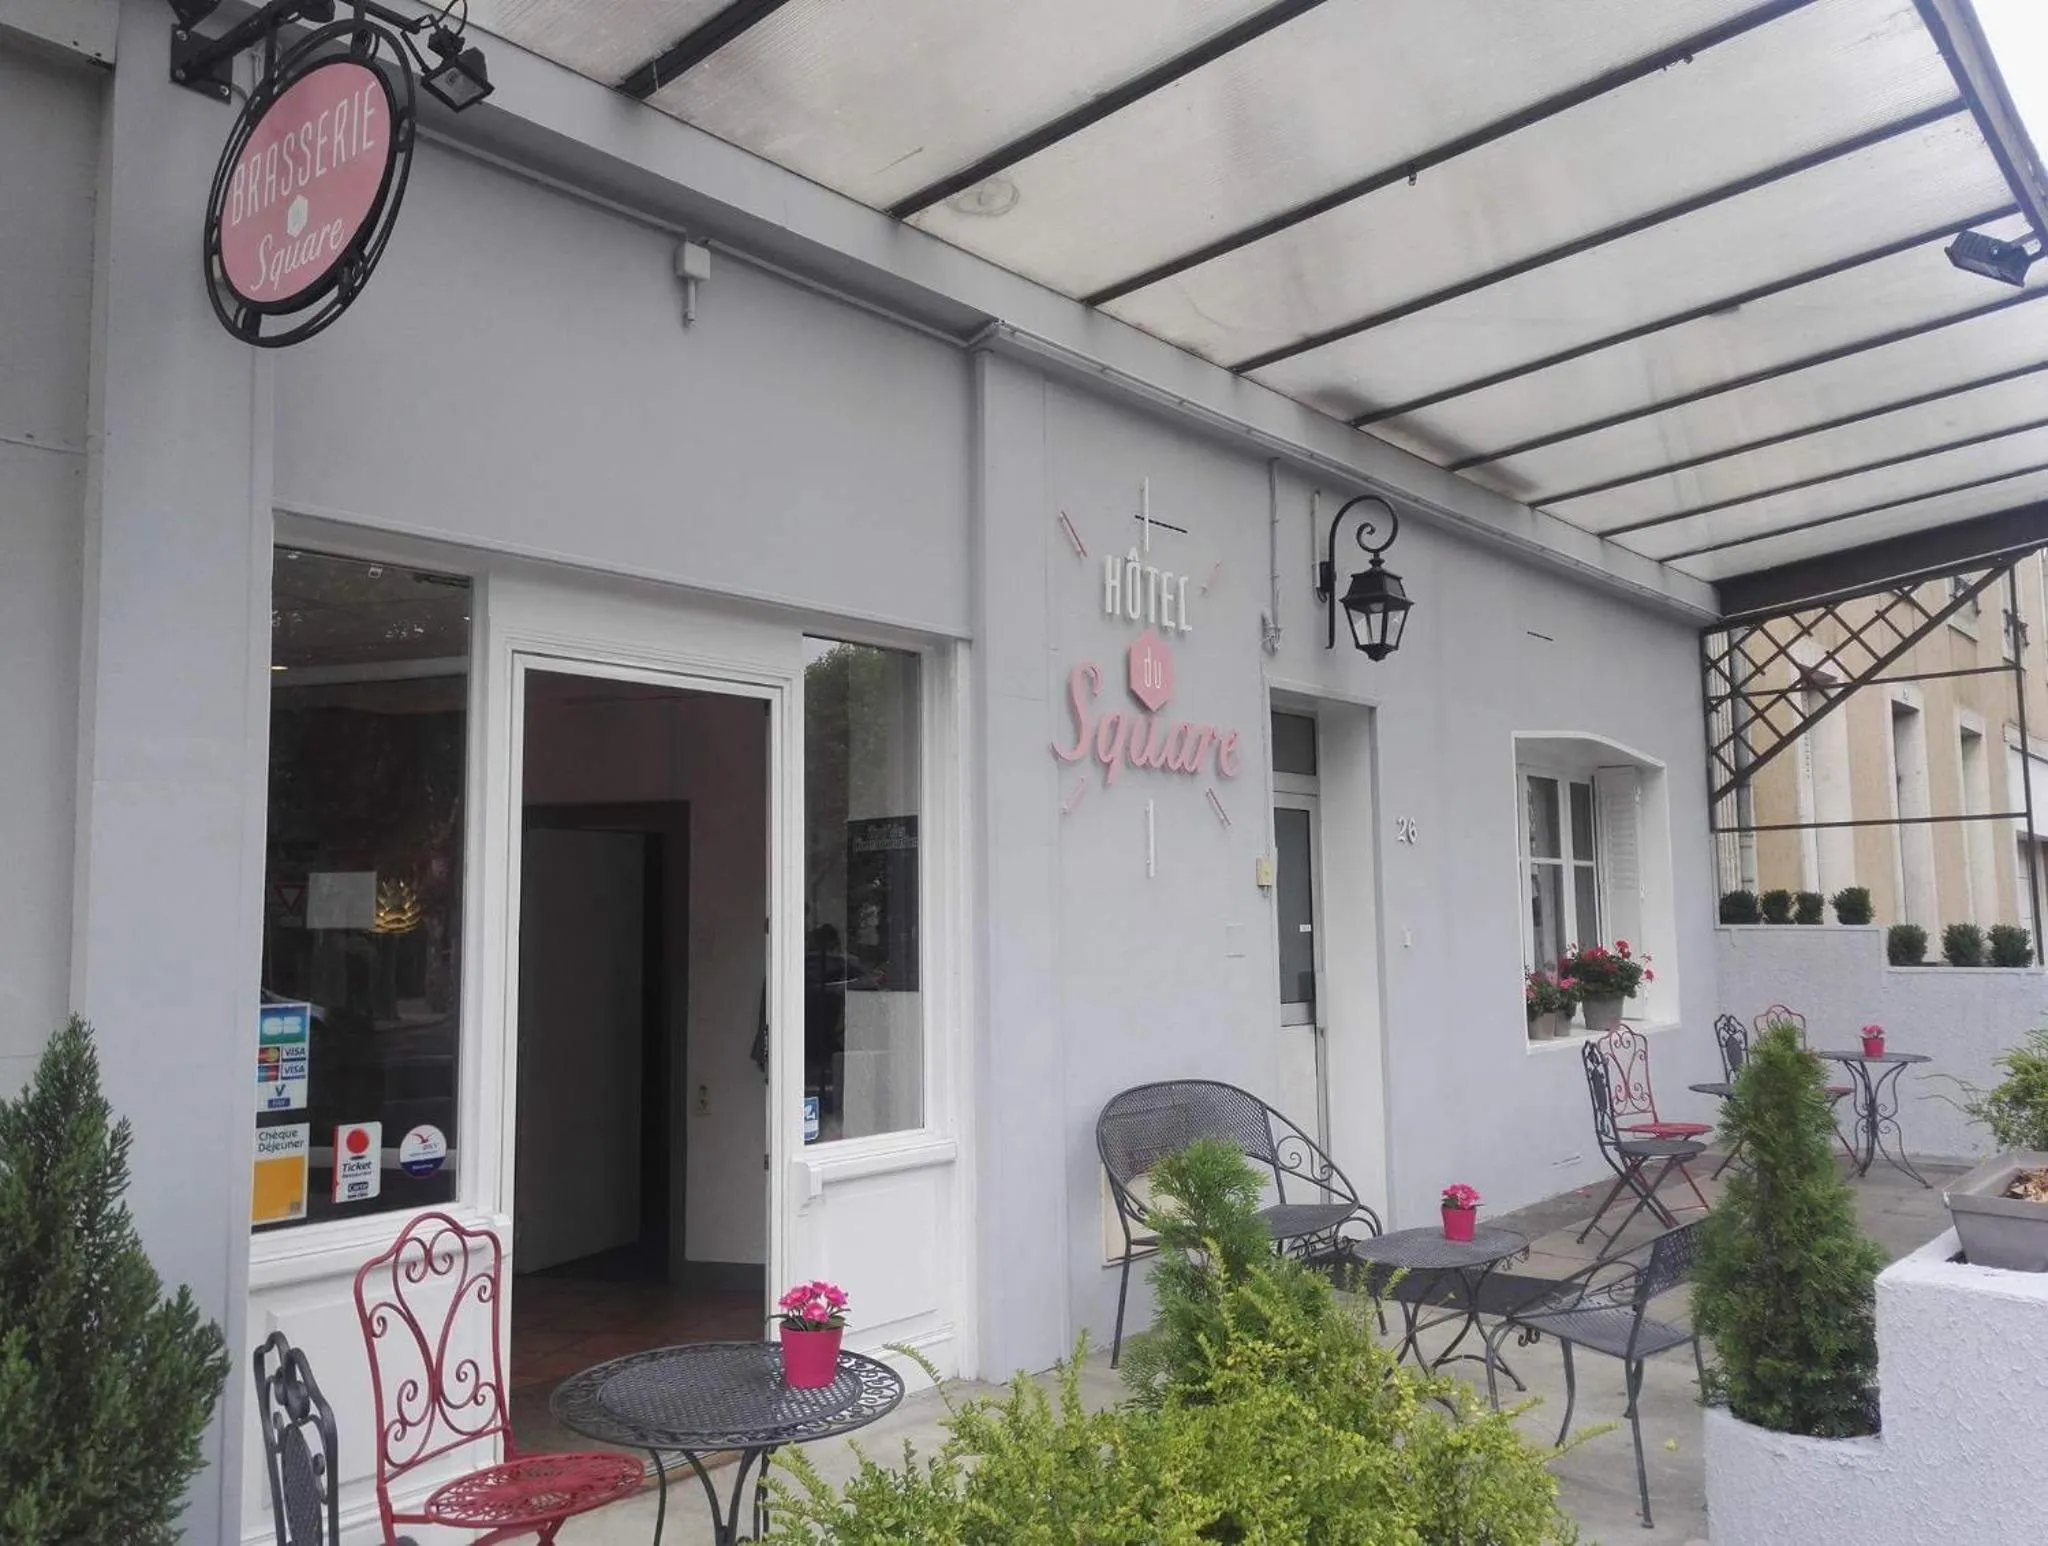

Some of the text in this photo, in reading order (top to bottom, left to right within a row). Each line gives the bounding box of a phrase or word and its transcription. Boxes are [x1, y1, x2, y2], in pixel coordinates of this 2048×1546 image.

[231, 82, 377, 227] BRASSERIE
[250, 218, 345, 291] Square
[1104, 547, 1193, 632] HÔTEL
[1144, 646, 1162, 688] du
[1050, 659, 1243, 786] Square
[1396, 816, 1418, 844] 26
[285, 1047, 306, 1057] VISA
[284, 1065, 305, 1075] VISA
[258, 1139, 304, 1153] Déjeuner
[342, 1161, 372, 1172] Ticket
